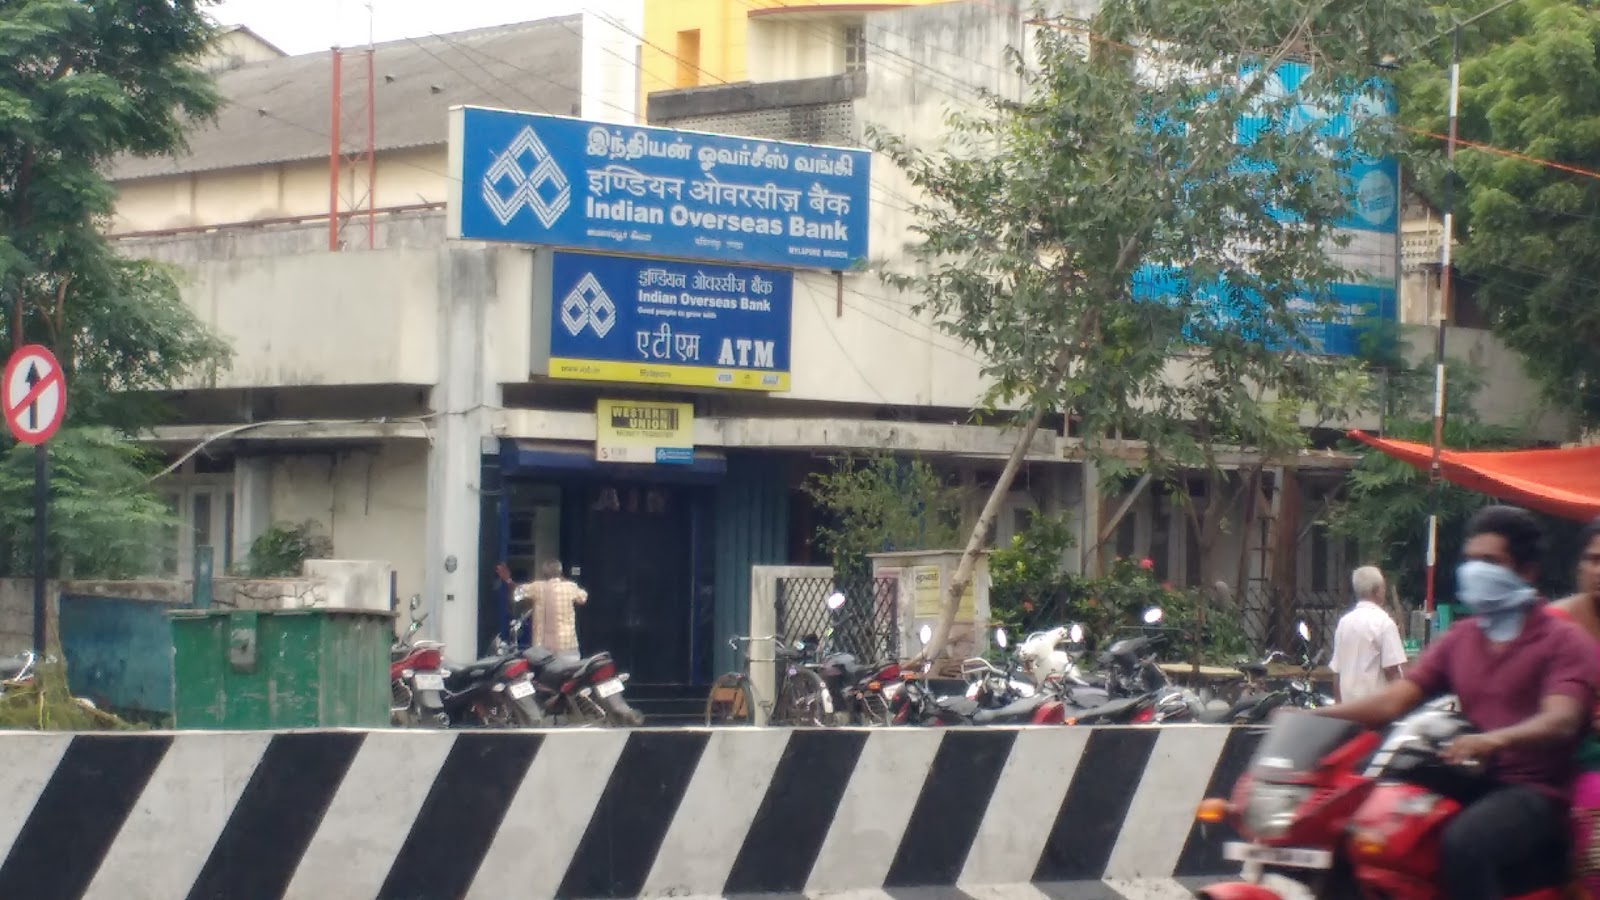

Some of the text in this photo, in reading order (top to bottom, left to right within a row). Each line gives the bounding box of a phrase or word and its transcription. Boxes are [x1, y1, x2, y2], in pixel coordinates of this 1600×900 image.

[587, 126, 693, 161] இந்தியன்
[794, 154, 853, 177] வங்கி
[586, 164, 686, 200] इण्डियन
[808, 182, 851, 216] बैंक
[587, 196, 664, 225] Indian
[670, 205, 783, 236] Overseas
[789, 215, 849, 241] Bank
[638, 289, 771, 312] Indian Overseas Bank
[718, 338, 775, 368] ATM
[612, 405, 668, 420] WESTERN
[629, 418, 668, 431] UNION
